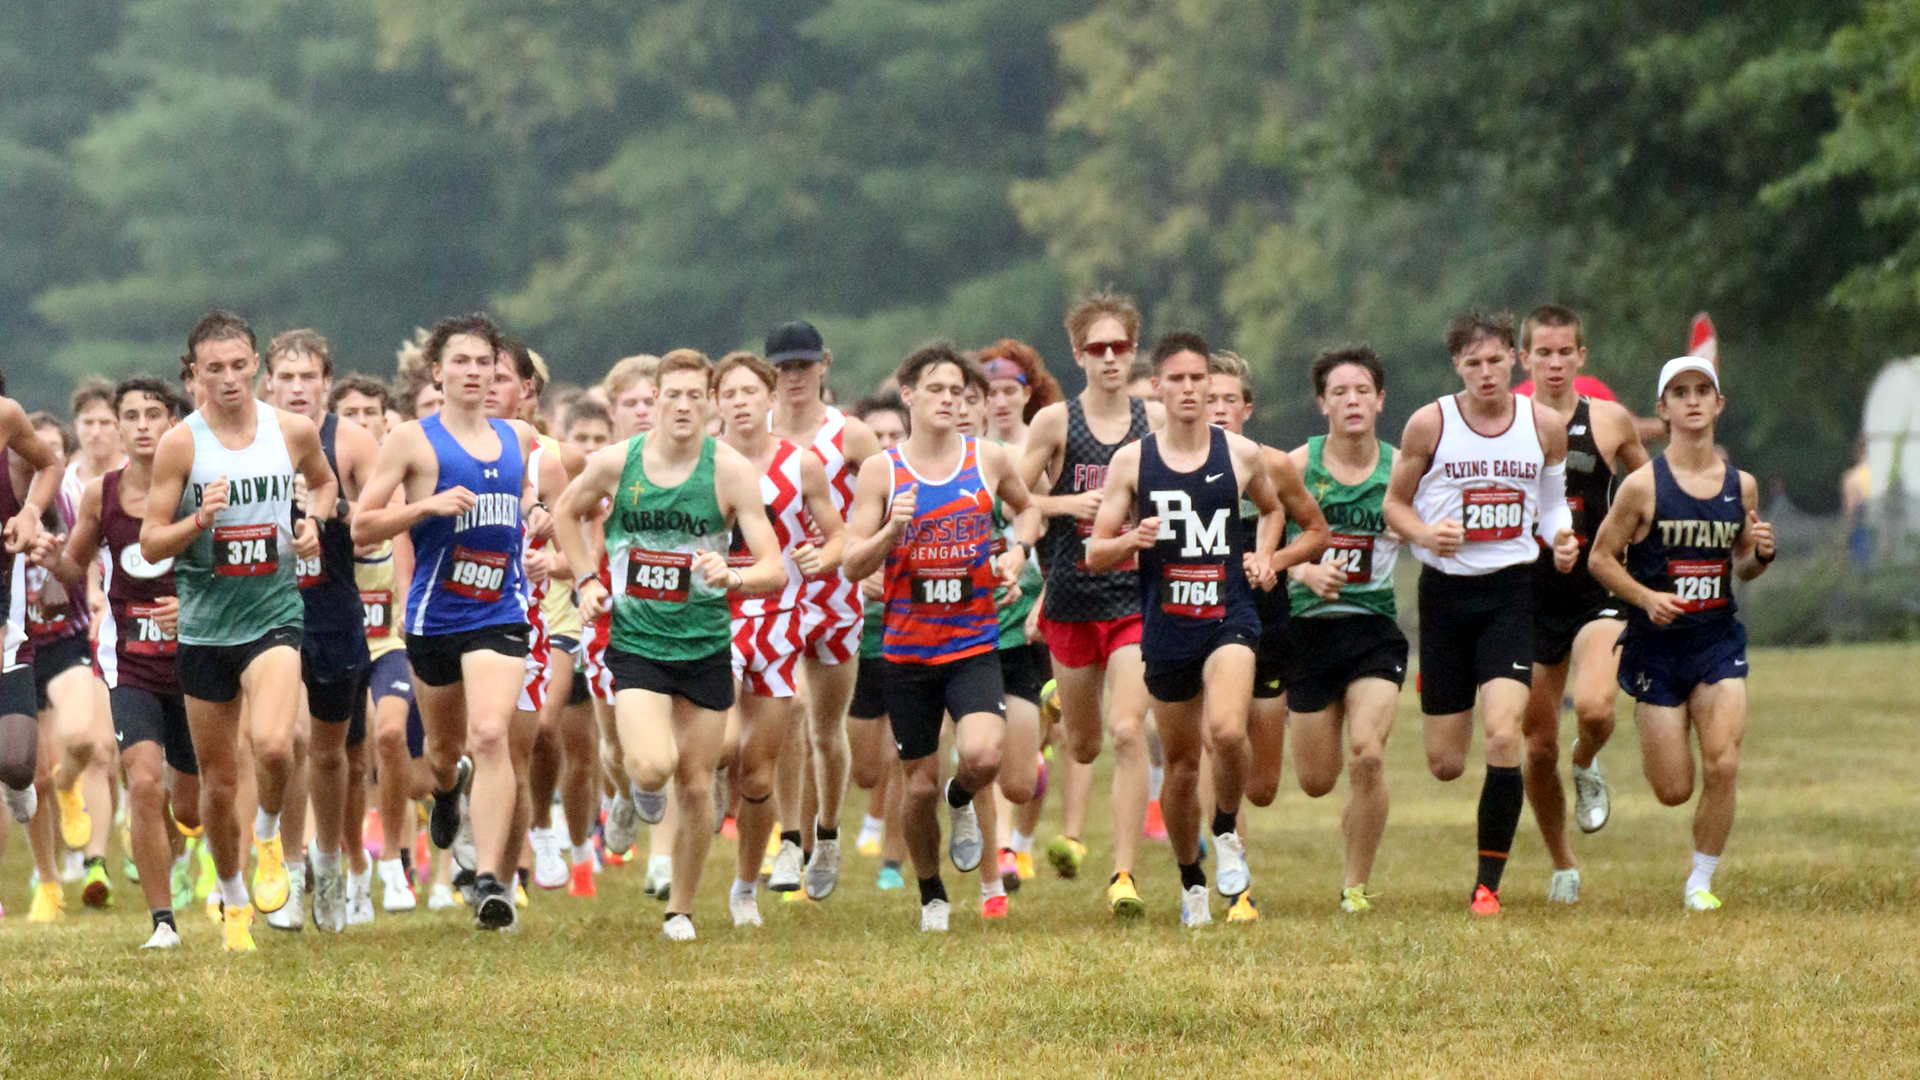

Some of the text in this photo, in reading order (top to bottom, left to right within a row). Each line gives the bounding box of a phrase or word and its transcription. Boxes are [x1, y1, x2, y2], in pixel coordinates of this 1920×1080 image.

[1445, 460, 1538, 479] FLYING EAGLES
[193, 475, 291, 508] BADWAY
[455, 493, 518, 533] RIVERBEN
[621, 509, 709, 537] GIBBONS
[1149, 490, 1231, 557] PM
[1466, 502, 1522, 529] 2680
[896, 512, 992, 548] ASSET
[227, 538, 268, 565] 374
[910, 543, 977, 559] BENGALS
[1320, 547, 1362, 573] 442
[452, 560, 505, 590] 1990
[636, 564, 680, 591] 433
[1673, 575, 1721, 600] 1261
[922, 578, 962, 603] 148
[1169, 580, 1219, 606] 1764
